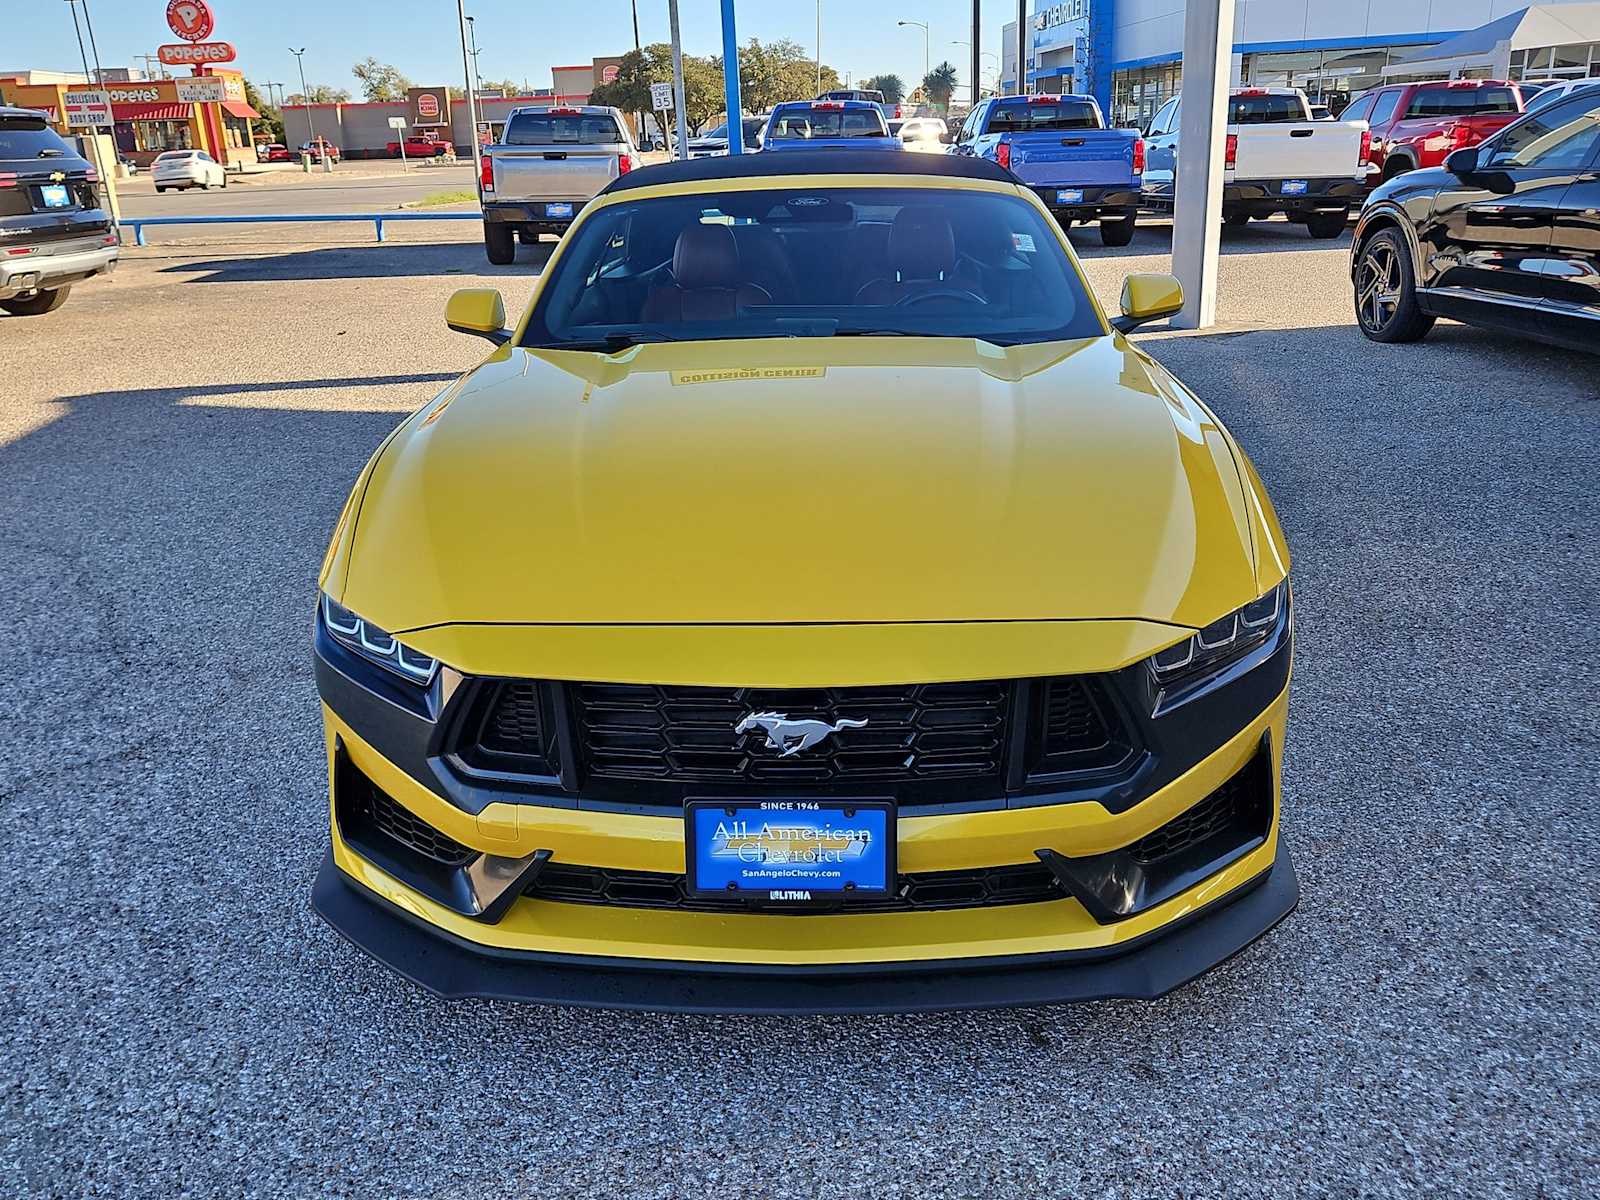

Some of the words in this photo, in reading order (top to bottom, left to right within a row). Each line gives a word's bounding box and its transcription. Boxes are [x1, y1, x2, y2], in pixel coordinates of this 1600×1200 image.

[1046, 0, 1084, 27] CHEVROLET
[171, 23, 208, 40] KITCHEN
[162, 45, 228, 61] POPEYES
[65, 93, 100, 105] COLLISION
[110, 87, 160, 103] OPEYES
[655, 97, 671, 108] 35
[69, 114, 87, 124] BODY
[87, 113, 106, 123] SHOP
[760, 802, 794, 811] SINCE
[796, 802, 820, 811] 1946
[711, 821, 747, 841] All
[756, 822, 873, 842] American
[737, 842, 844, 865] Chevrolet
[741, 869, 841, 879] SanAngeloChevy.com
[779, 890, 812, 901] LITHIA
